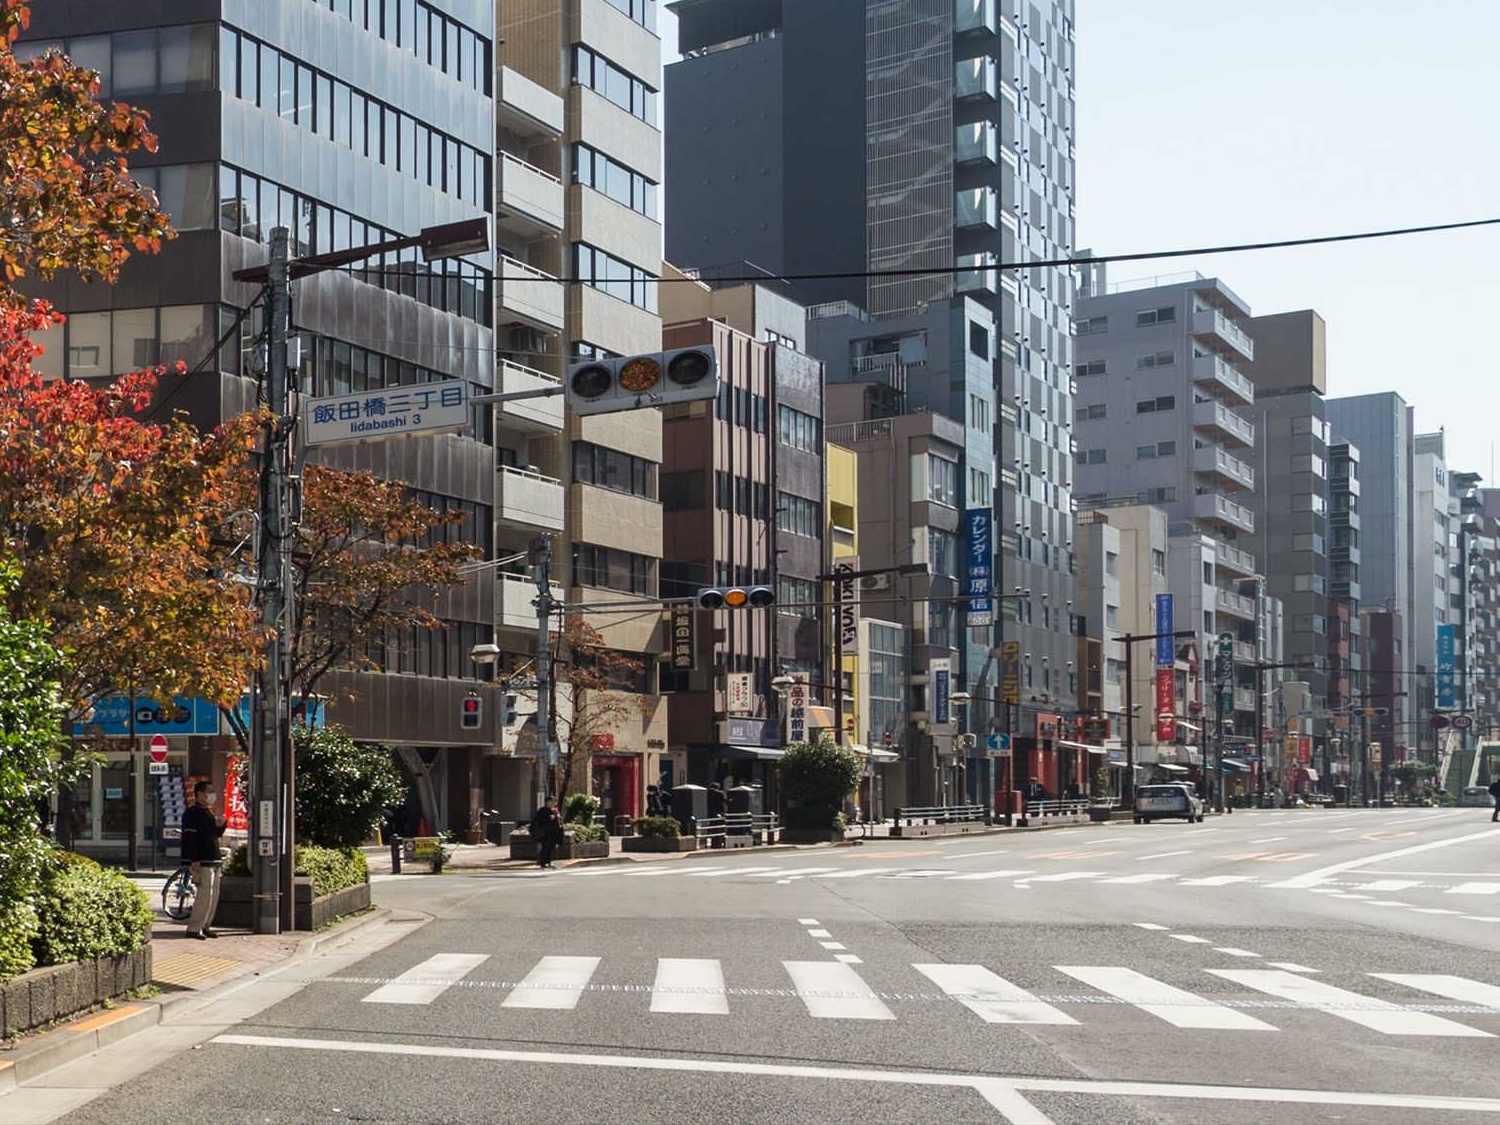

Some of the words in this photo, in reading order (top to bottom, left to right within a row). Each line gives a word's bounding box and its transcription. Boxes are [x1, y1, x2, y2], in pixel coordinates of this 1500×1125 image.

[313, 387, 462, 425] 飯田橋三丁目
[350, 416, 407, 433] Iidabashi
[412, 414, 422, 425] 3
[971, 515, 988, 563] カレンダー
